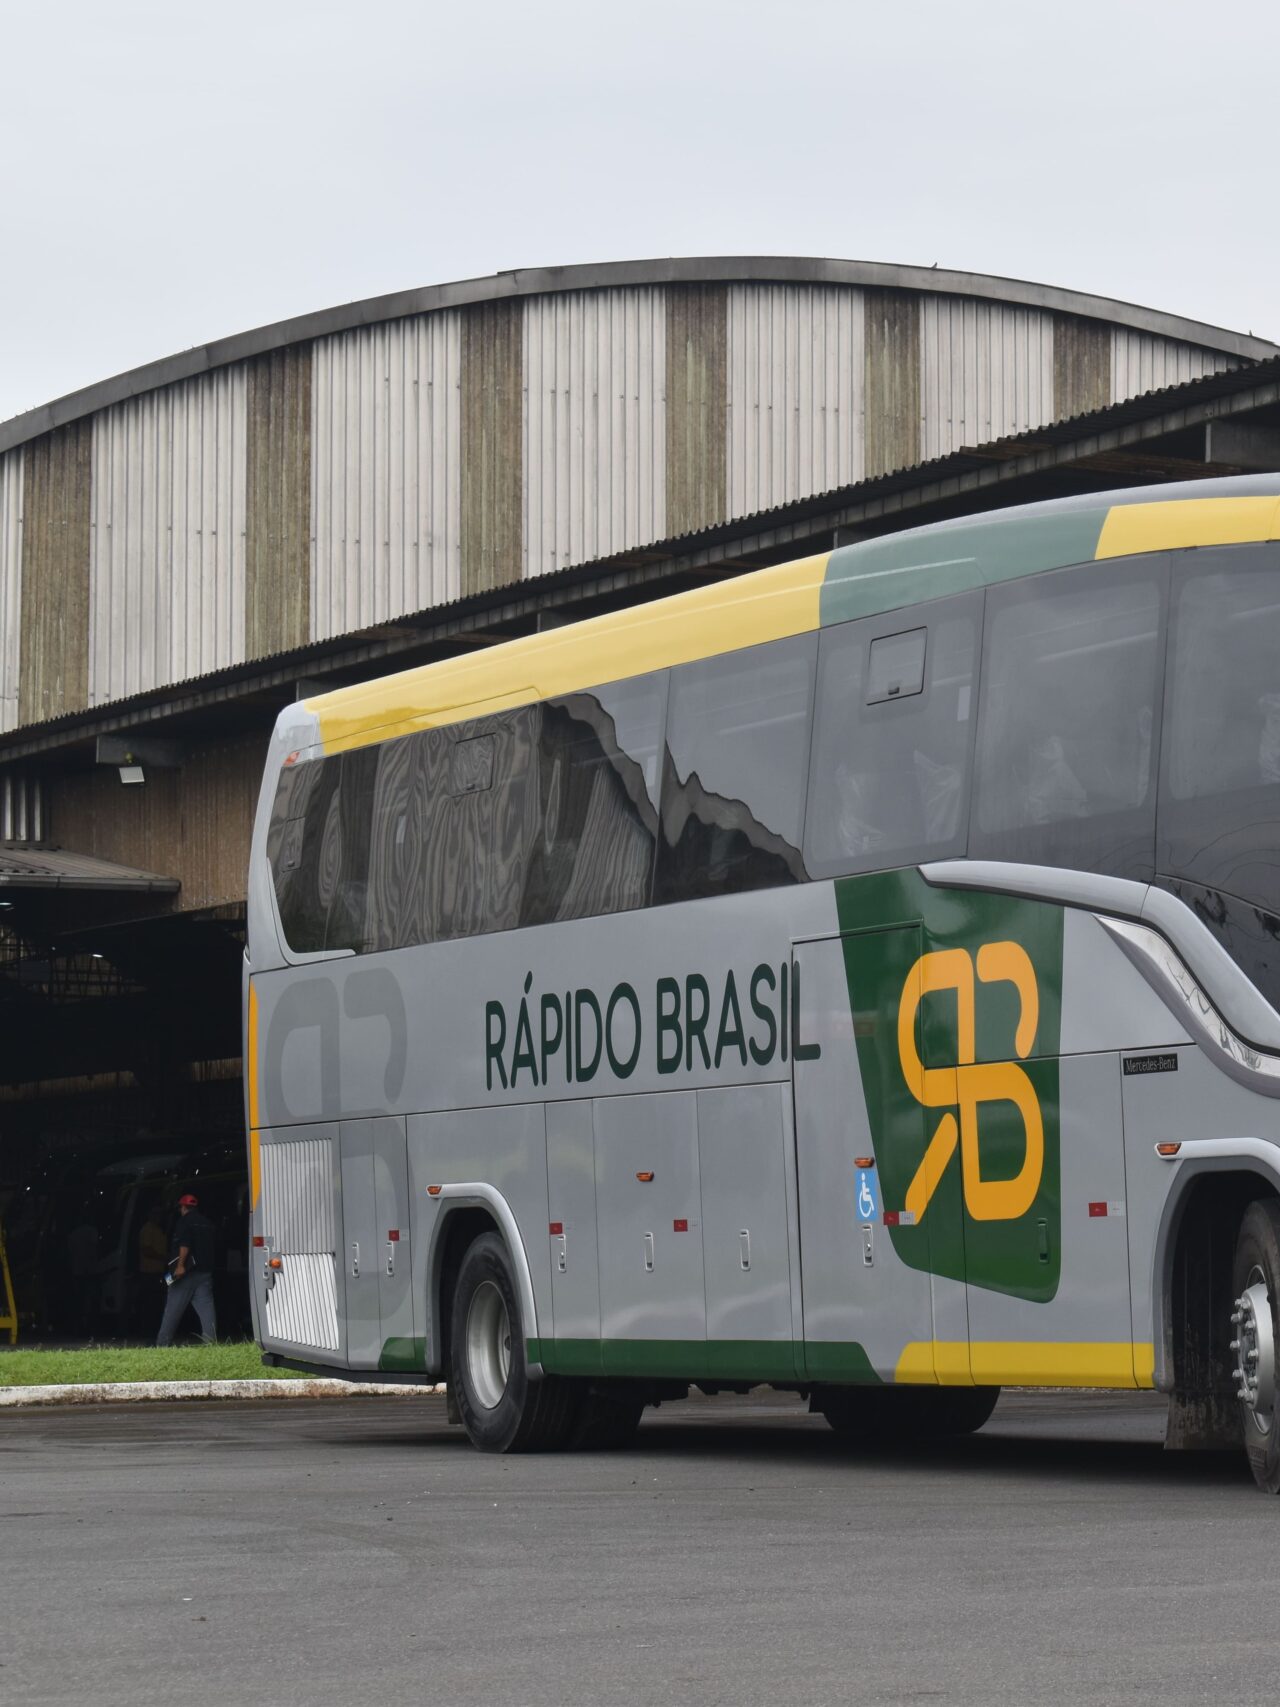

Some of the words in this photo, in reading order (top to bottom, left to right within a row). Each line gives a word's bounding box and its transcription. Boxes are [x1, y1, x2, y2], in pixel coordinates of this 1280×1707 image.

[485, 970, 642, 1091] RÁPIDO
[656, 960, 821, 1074] BRASIL
[1125, 1056, 1177, 1073] Mercedes-Benz
